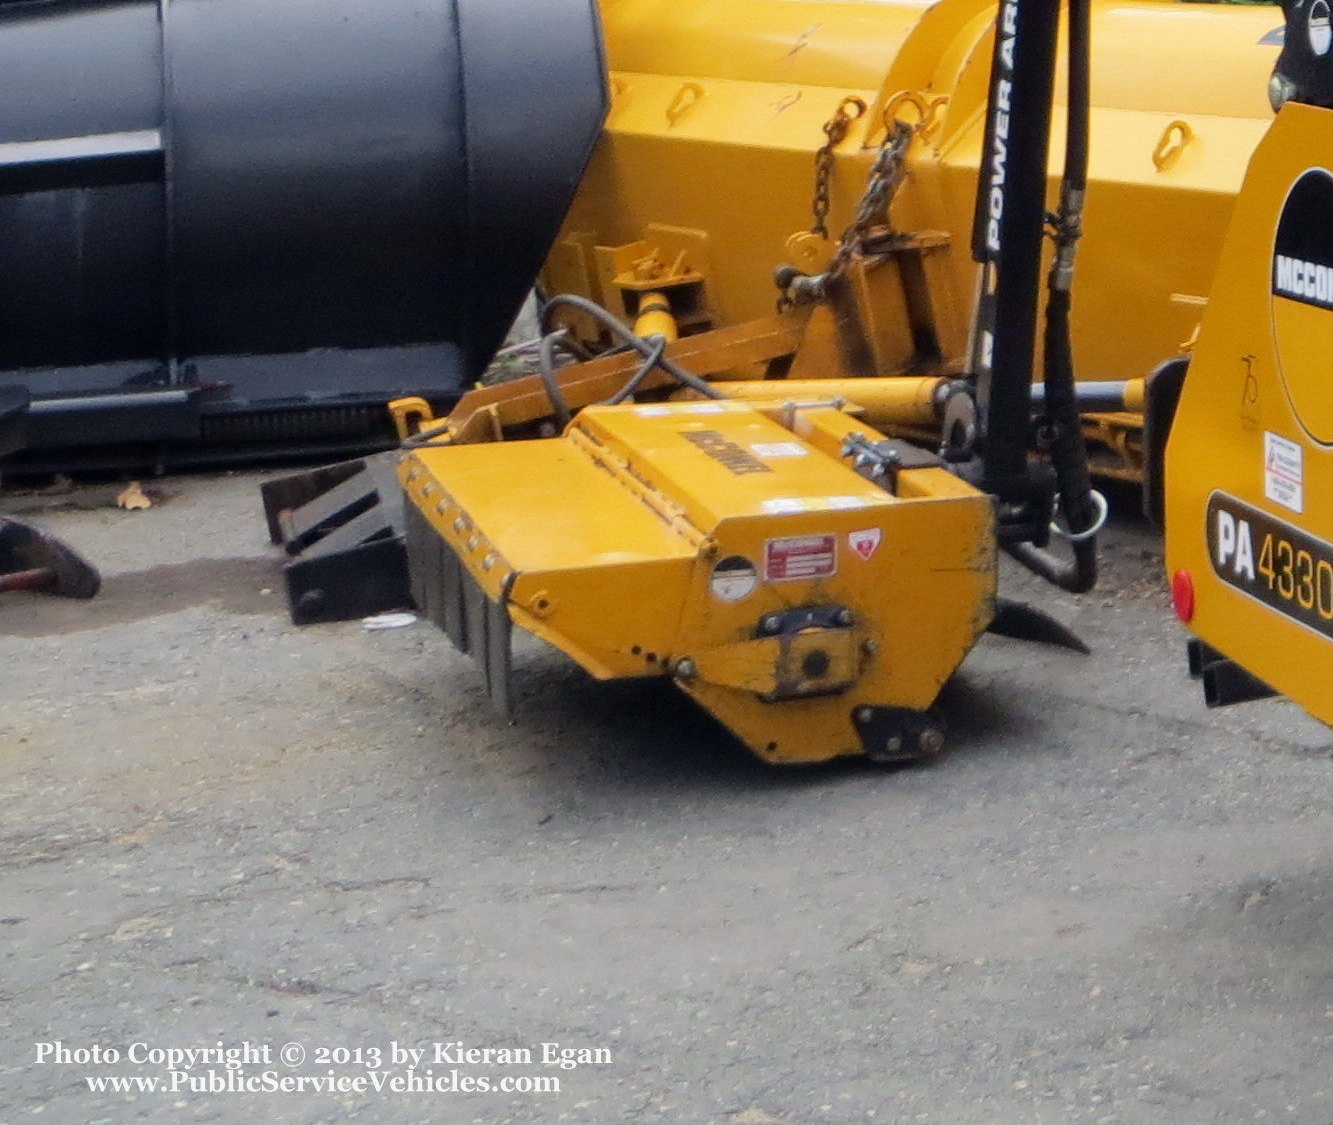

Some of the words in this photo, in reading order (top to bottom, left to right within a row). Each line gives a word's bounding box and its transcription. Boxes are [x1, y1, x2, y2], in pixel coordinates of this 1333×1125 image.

[986, 79, 1011, 251] POWER
[1218, 510, 1255, 580] PA
[1258, 534, 1333, 619] 4330
